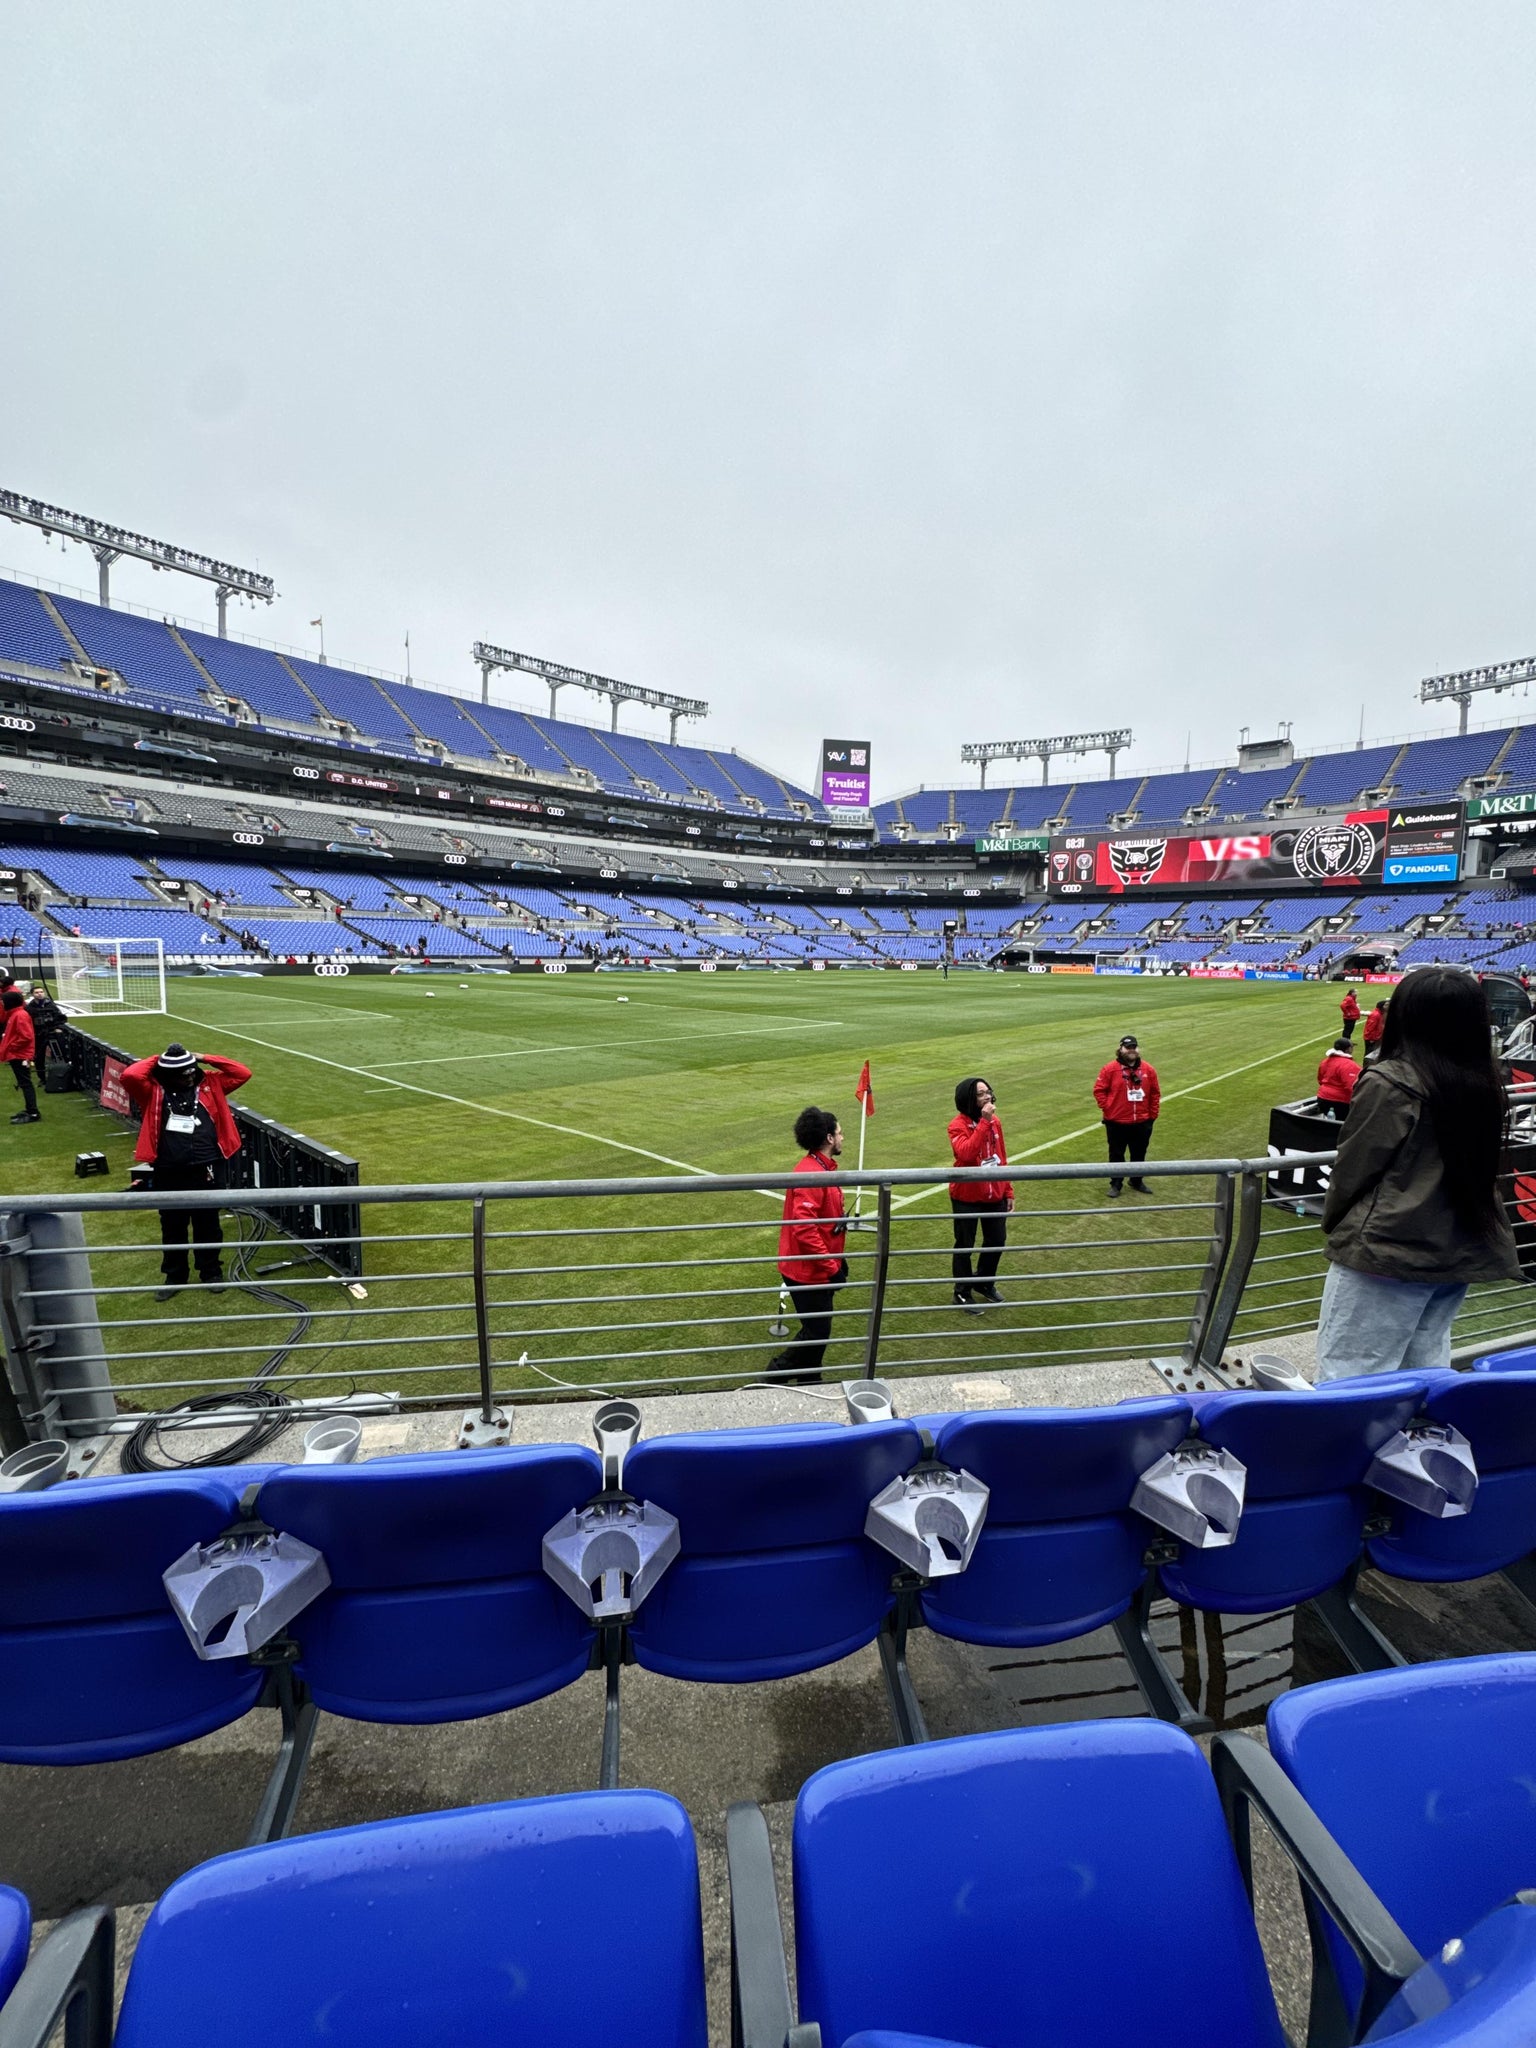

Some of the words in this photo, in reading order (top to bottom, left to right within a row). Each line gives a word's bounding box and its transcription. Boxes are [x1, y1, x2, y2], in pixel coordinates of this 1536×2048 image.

[29, 680, 60, 691] BALTIMORE
[61, 686, 79, 695] COLTS
[172, 709, 196, 718] ARTHUR
[204, 715, 227, 725] MODELL
[265, 727, 289, 737] MICHAEL
[365, 780, 389, 790] UNITED
[826, 777, 866, 789] Fruitist
[1479, 794, 1532, 816] M&T
[1405, 812, 1458, 824] Guidehouse
[982, 839, 1013, 851] M&T
[1012, 838, 1041, 850] Bank
[1318, 835, 1350, 844] MIAMI
[1200, 836, 1262, 861] VS
[1080, 869, 1087, 881] 0
[1405, 864, 1451, 874] FANDUEL
[1057, 870, 1064, 882] 0
[1369, 975, 1390, 983] Audi
